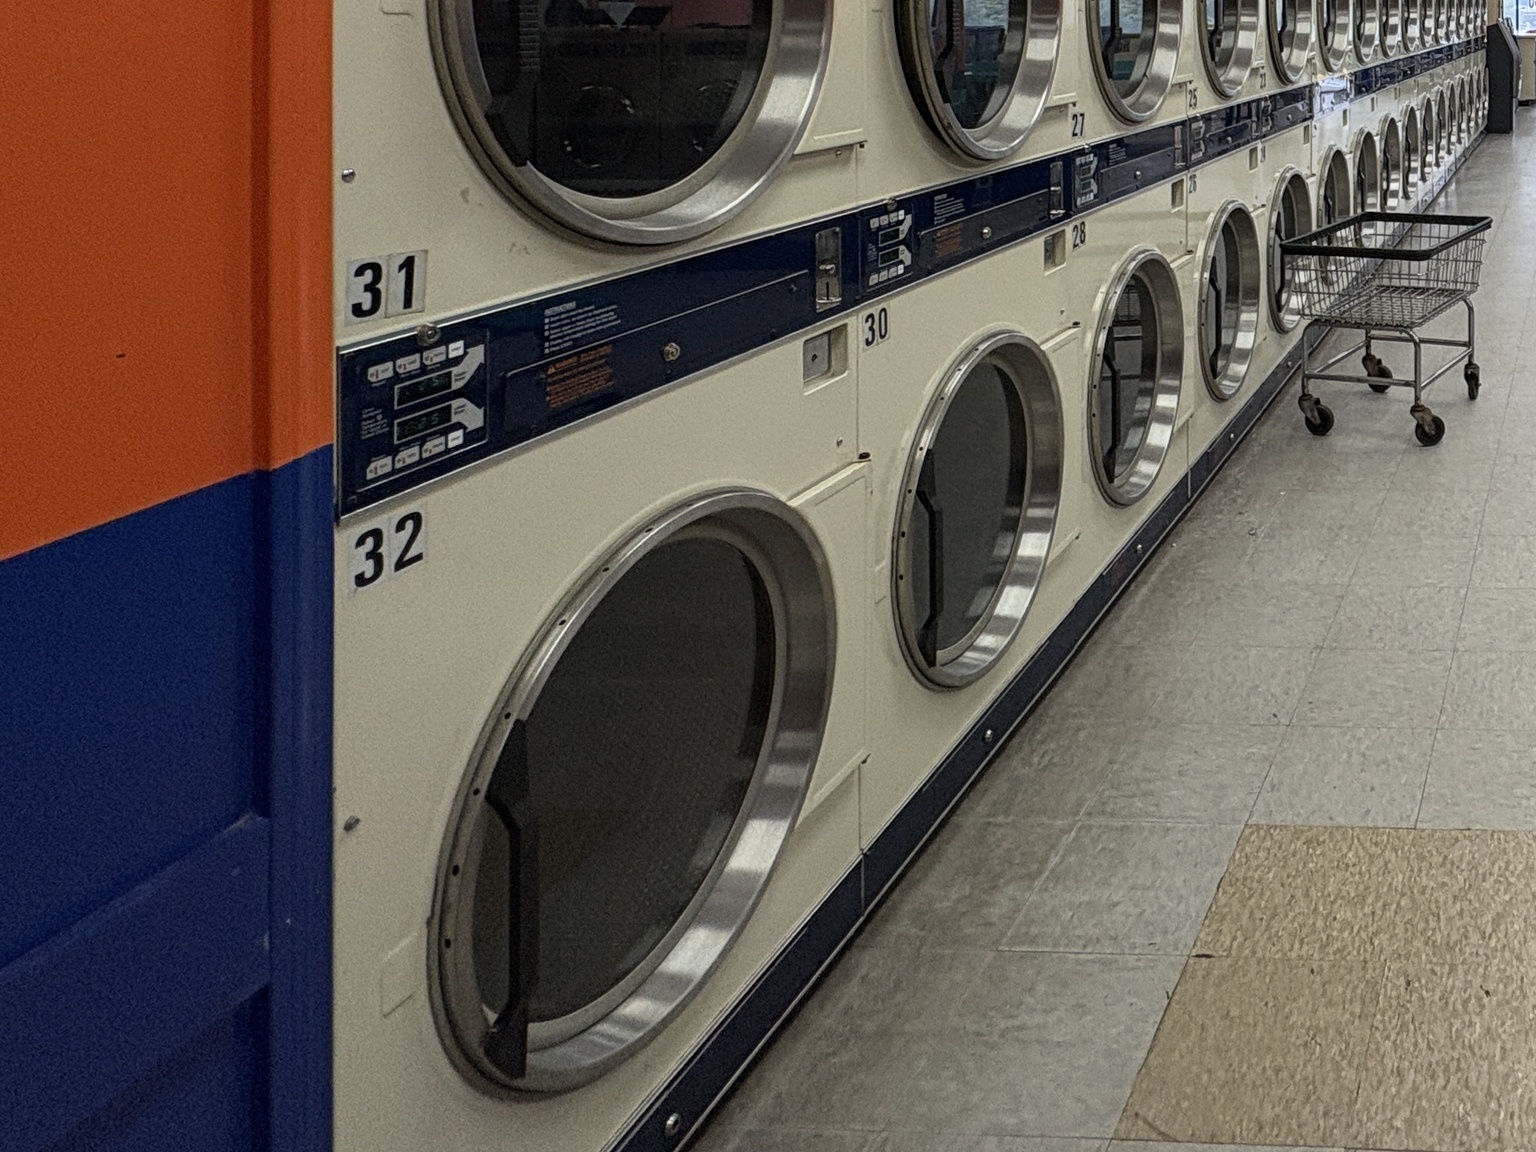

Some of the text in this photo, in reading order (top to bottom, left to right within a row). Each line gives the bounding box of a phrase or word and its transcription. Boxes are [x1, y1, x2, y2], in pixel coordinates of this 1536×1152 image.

[1188, 88, 1198, 108] 25
[1071, 113, 1085, 137] 27
[1072, 221, 1086, 248] 28
[351, 255, 416, 318] 31
[864, 307, 888, 347] 30
[354, 511, 424, 588] 32
